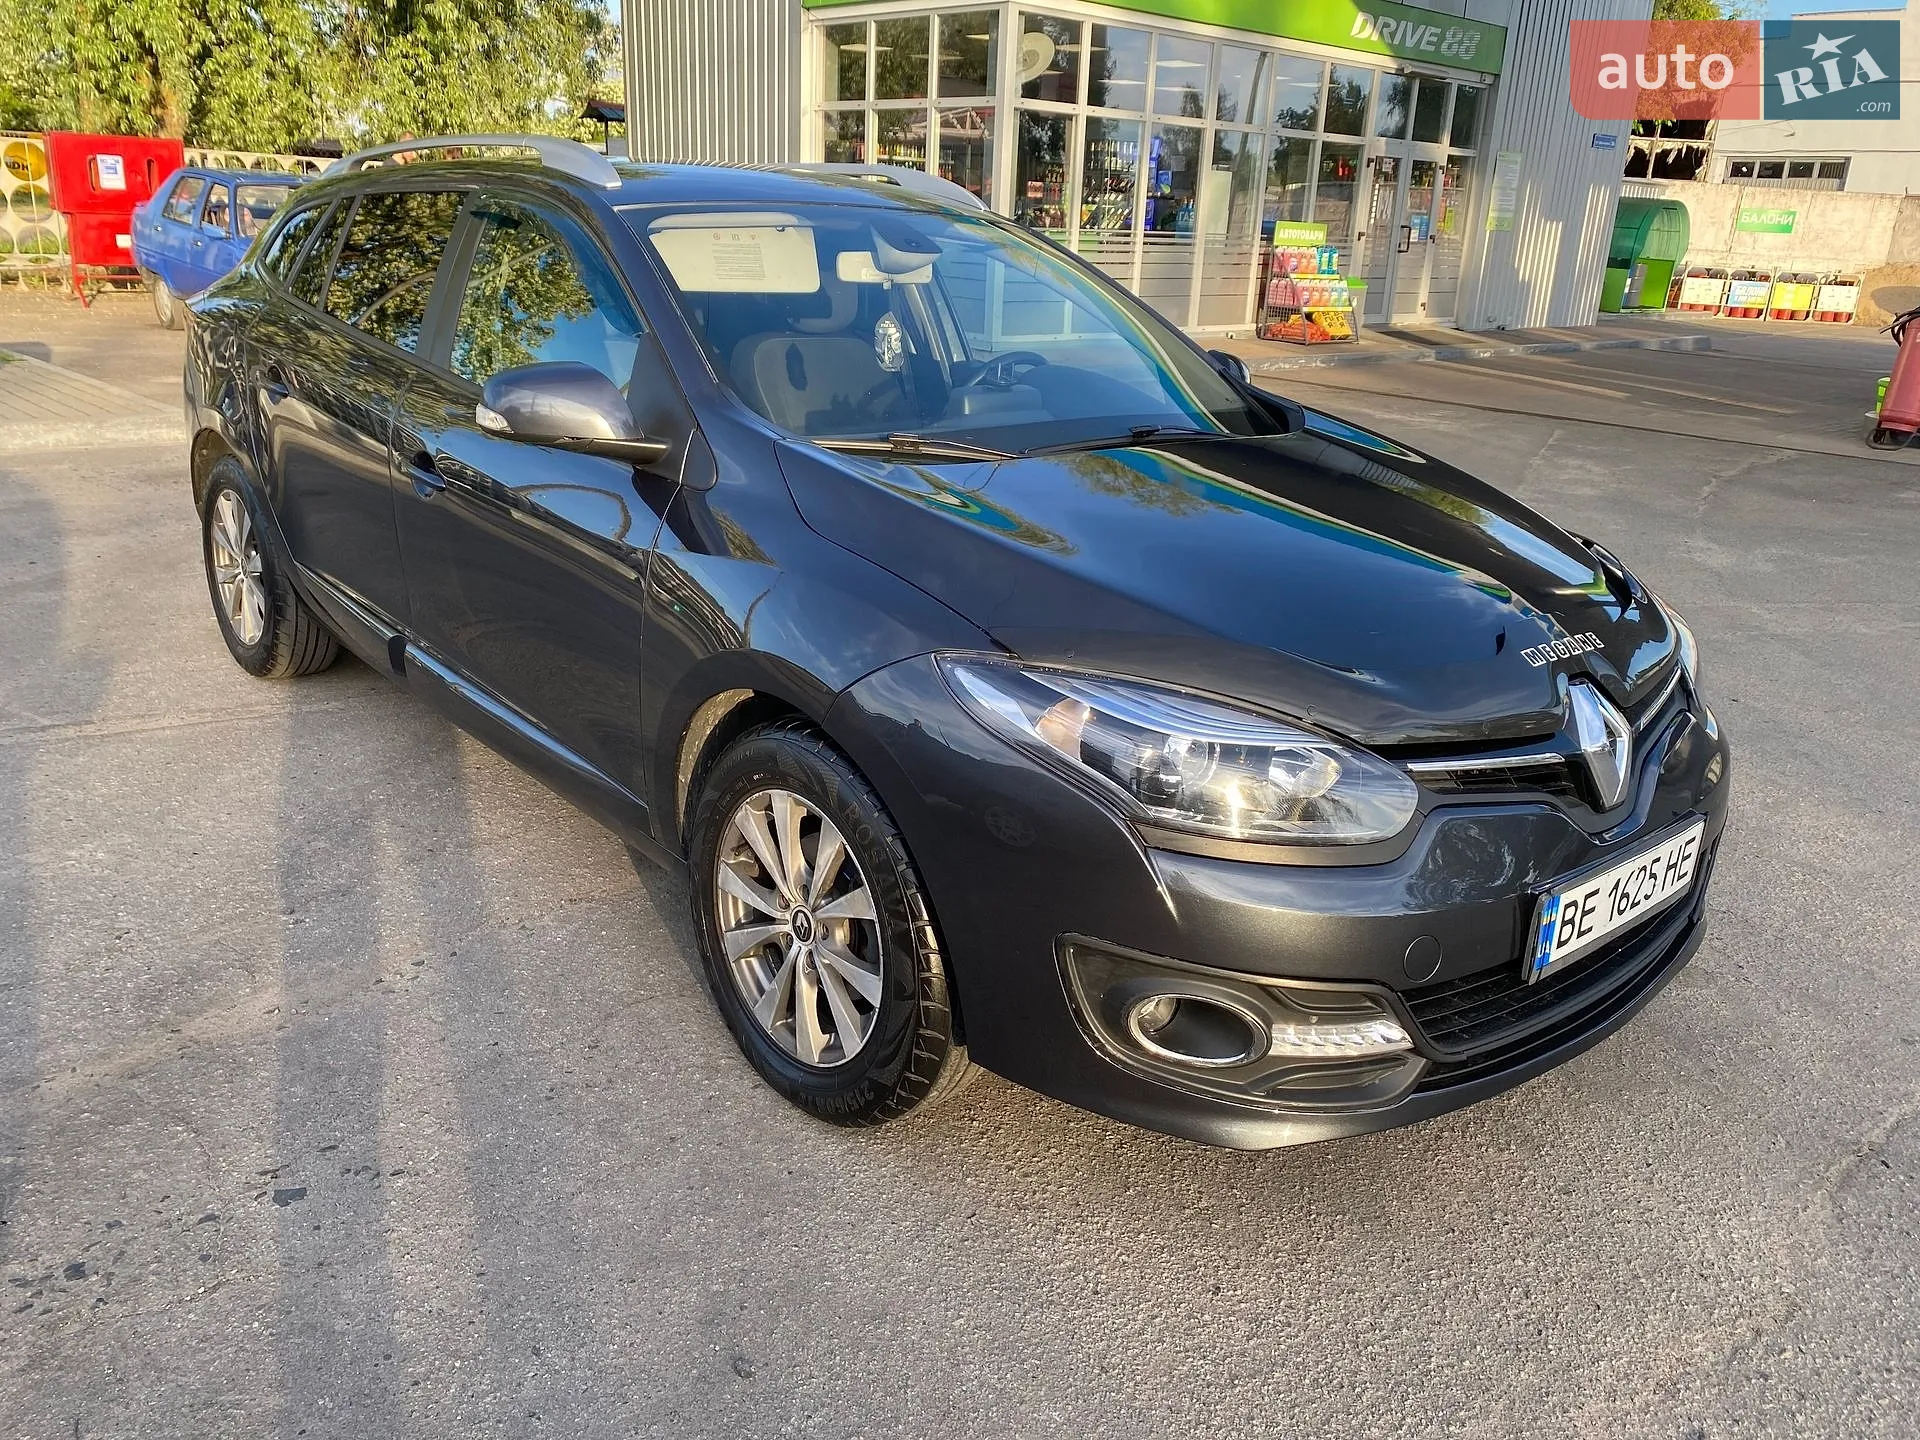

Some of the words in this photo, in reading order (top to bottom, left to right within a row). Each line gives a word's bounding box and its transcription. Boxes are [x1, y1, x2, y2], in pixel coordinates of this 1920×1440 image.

[1350, 11, 1441, 52] DRIVE
[1740, 213, 1794, 226] БАЛОНИ
[1520, 631, 1605, 668] MEGANE
[1556, 887, 1601, 950] BE
[1608, 856, 1662, 923] 1625
[1661, 835, 1697, 892] HE
